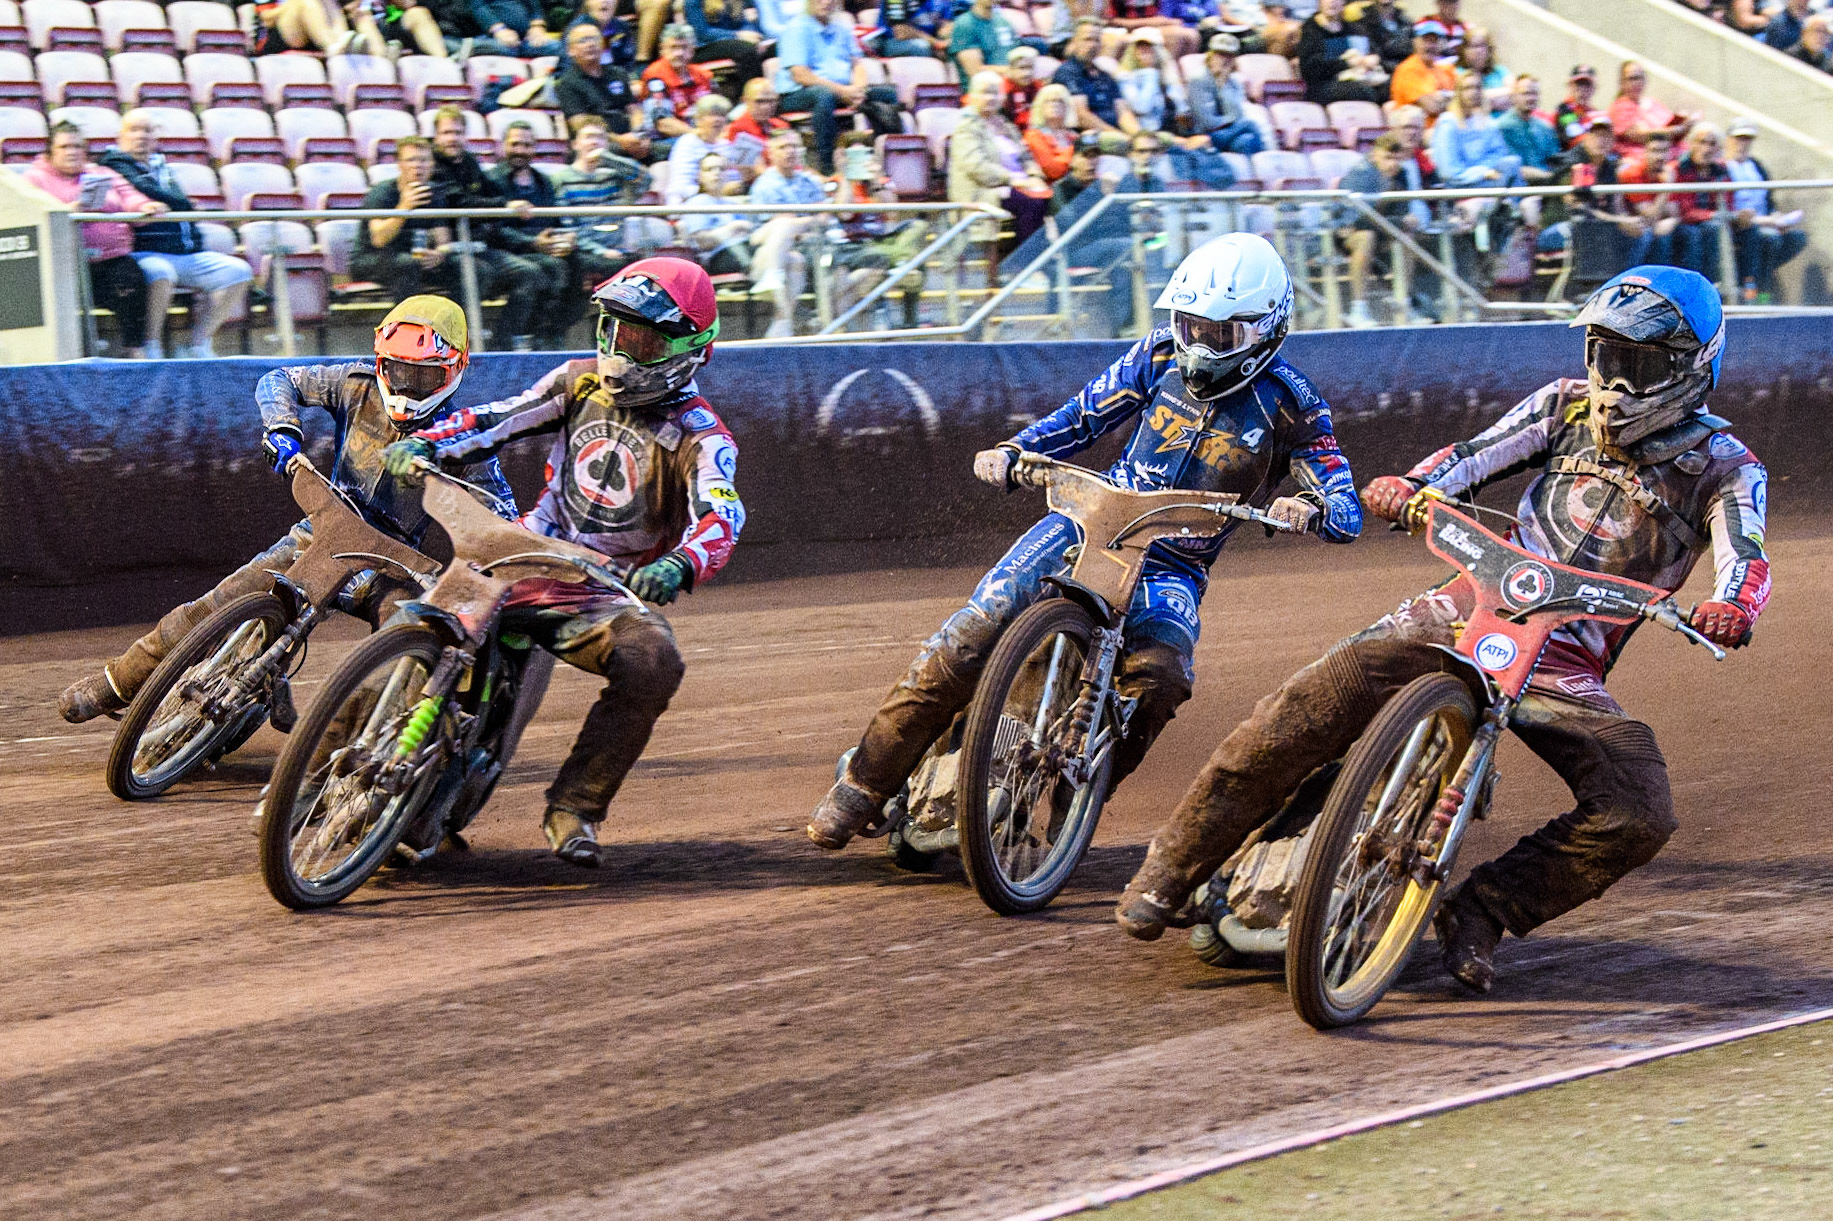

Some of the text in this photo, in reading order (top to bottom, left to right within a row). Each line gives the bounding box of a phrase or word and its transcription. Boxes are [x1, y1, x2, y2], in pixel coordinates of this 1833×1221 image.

[574, 426, 608, 448] BELLE
[1241, 427, 1265, 448] 4
[1003, 522, 1065, 575] MacInnes
[1482, 643, 1509, 661] ATPI
